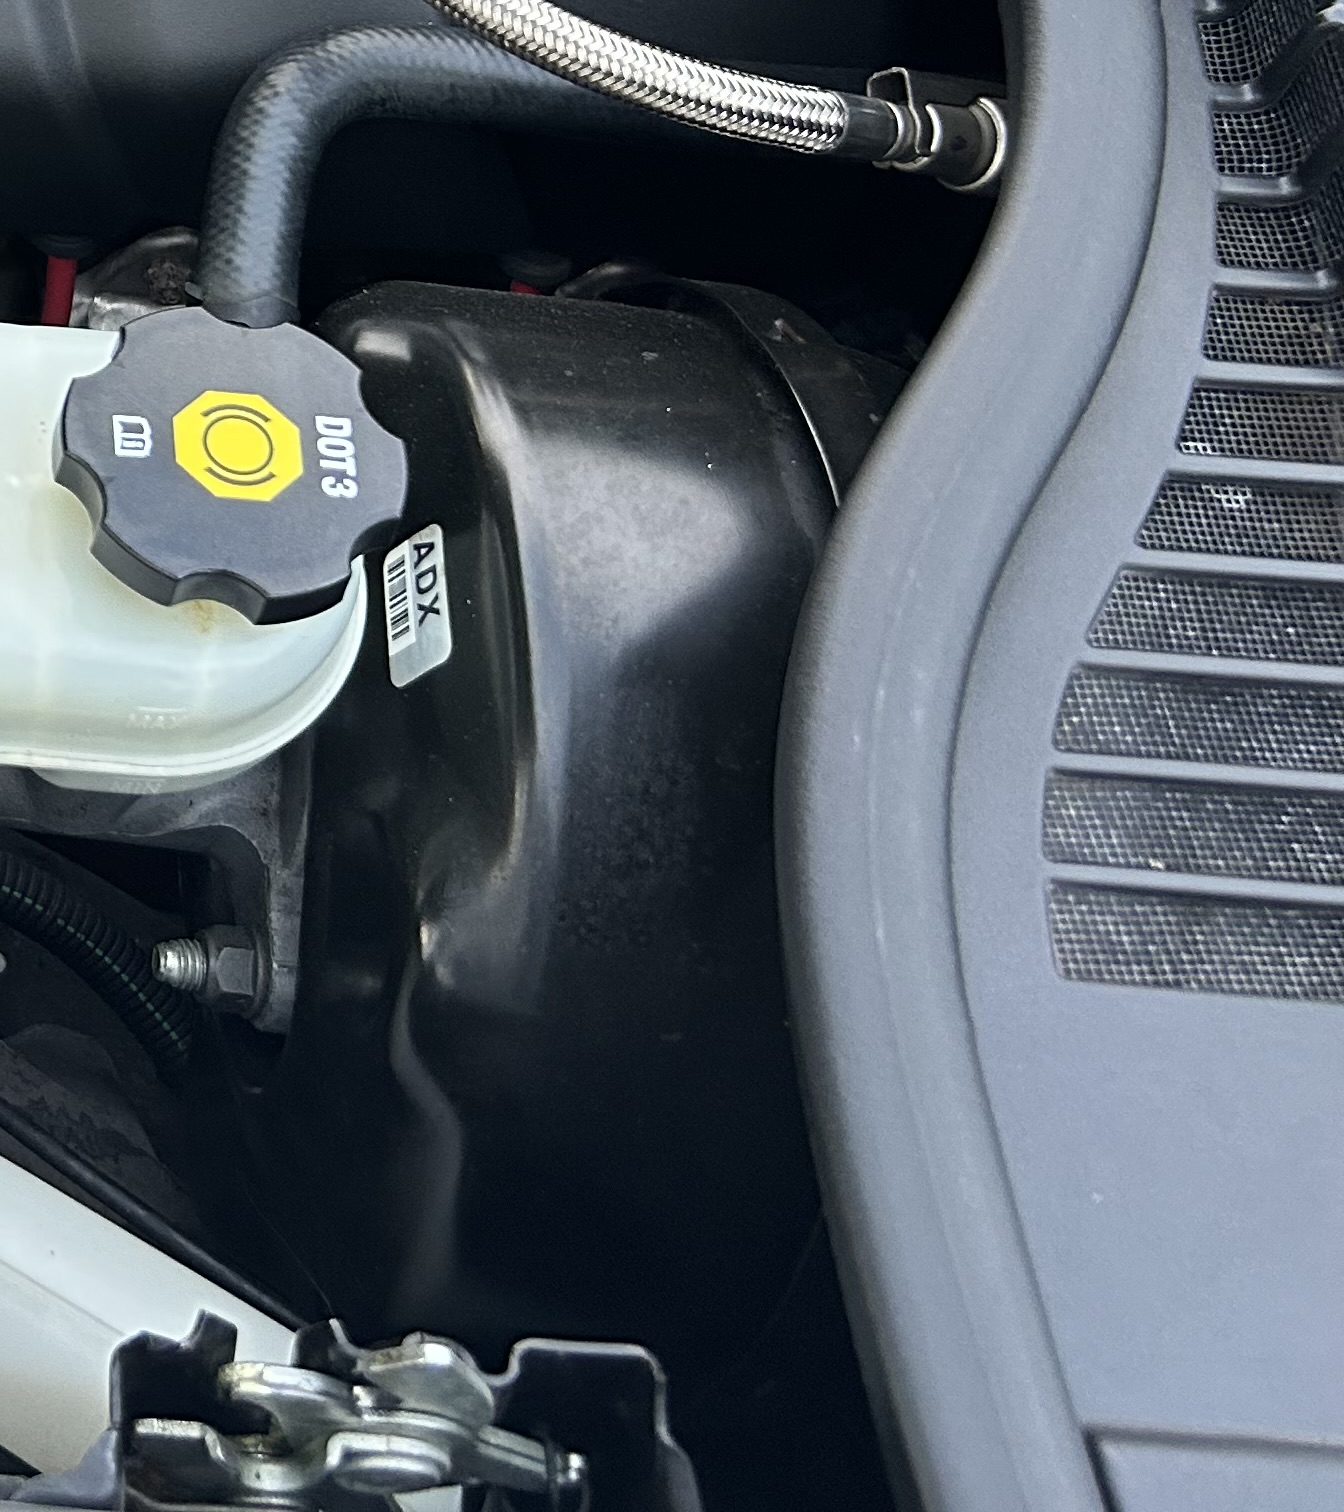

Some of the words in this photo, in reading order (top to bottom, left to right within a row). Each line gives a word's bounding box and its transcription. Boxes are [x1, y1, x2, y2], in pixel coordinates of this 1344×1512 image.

[314, 414, 357, 477] DOT
[321, 475, 360, 500] 3
[413, 541, 441, 628] ADX
